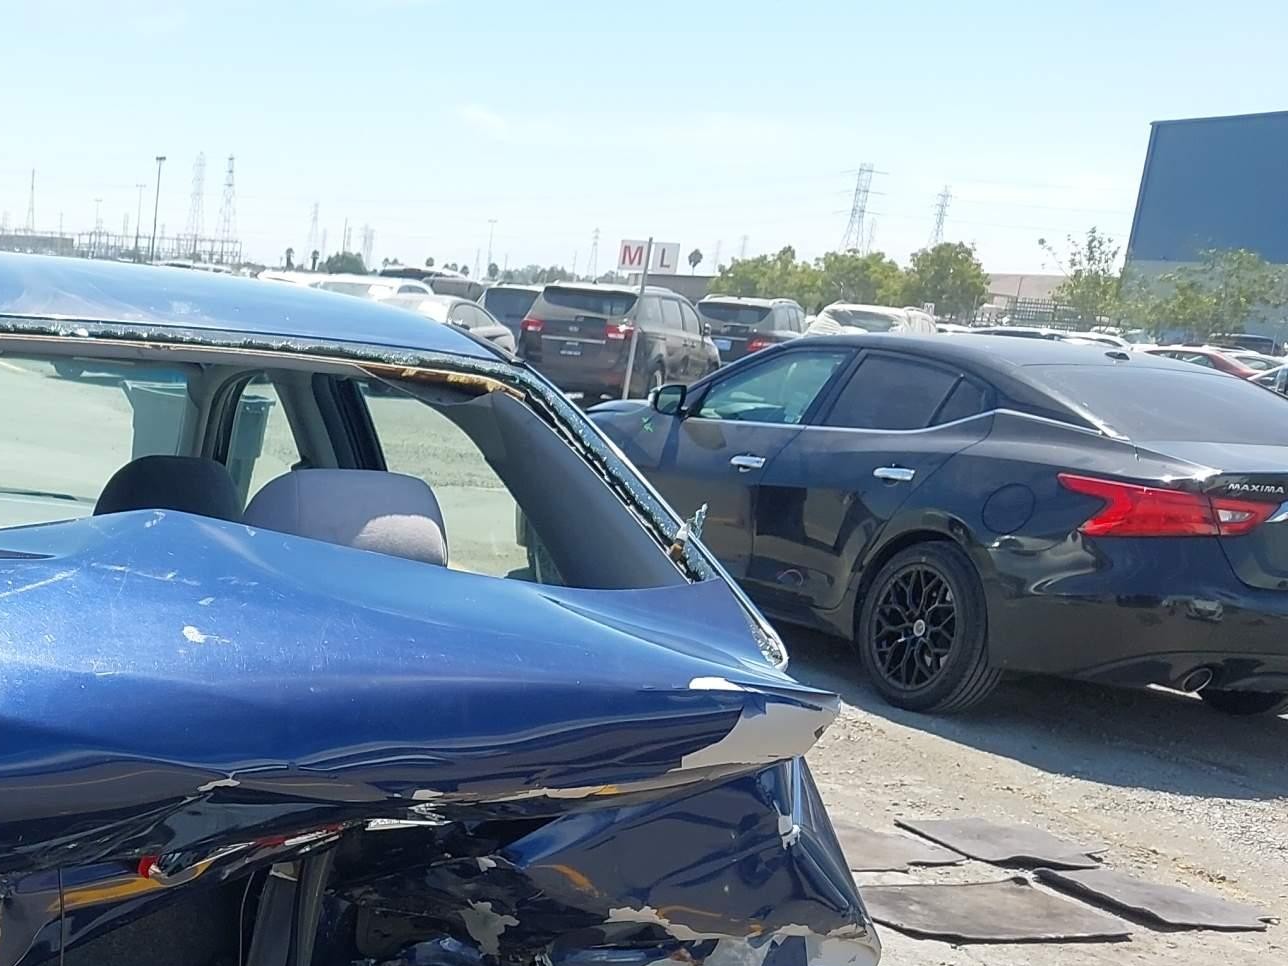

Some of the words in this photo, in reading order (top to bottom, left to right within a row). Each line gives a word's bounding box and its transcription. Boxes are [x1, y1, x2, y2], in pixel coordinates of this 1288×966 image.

[621, 245, 643, 266] M
[659, 247, 671, 268] L
[1227, 483, 1285, 494] MAXIMA
